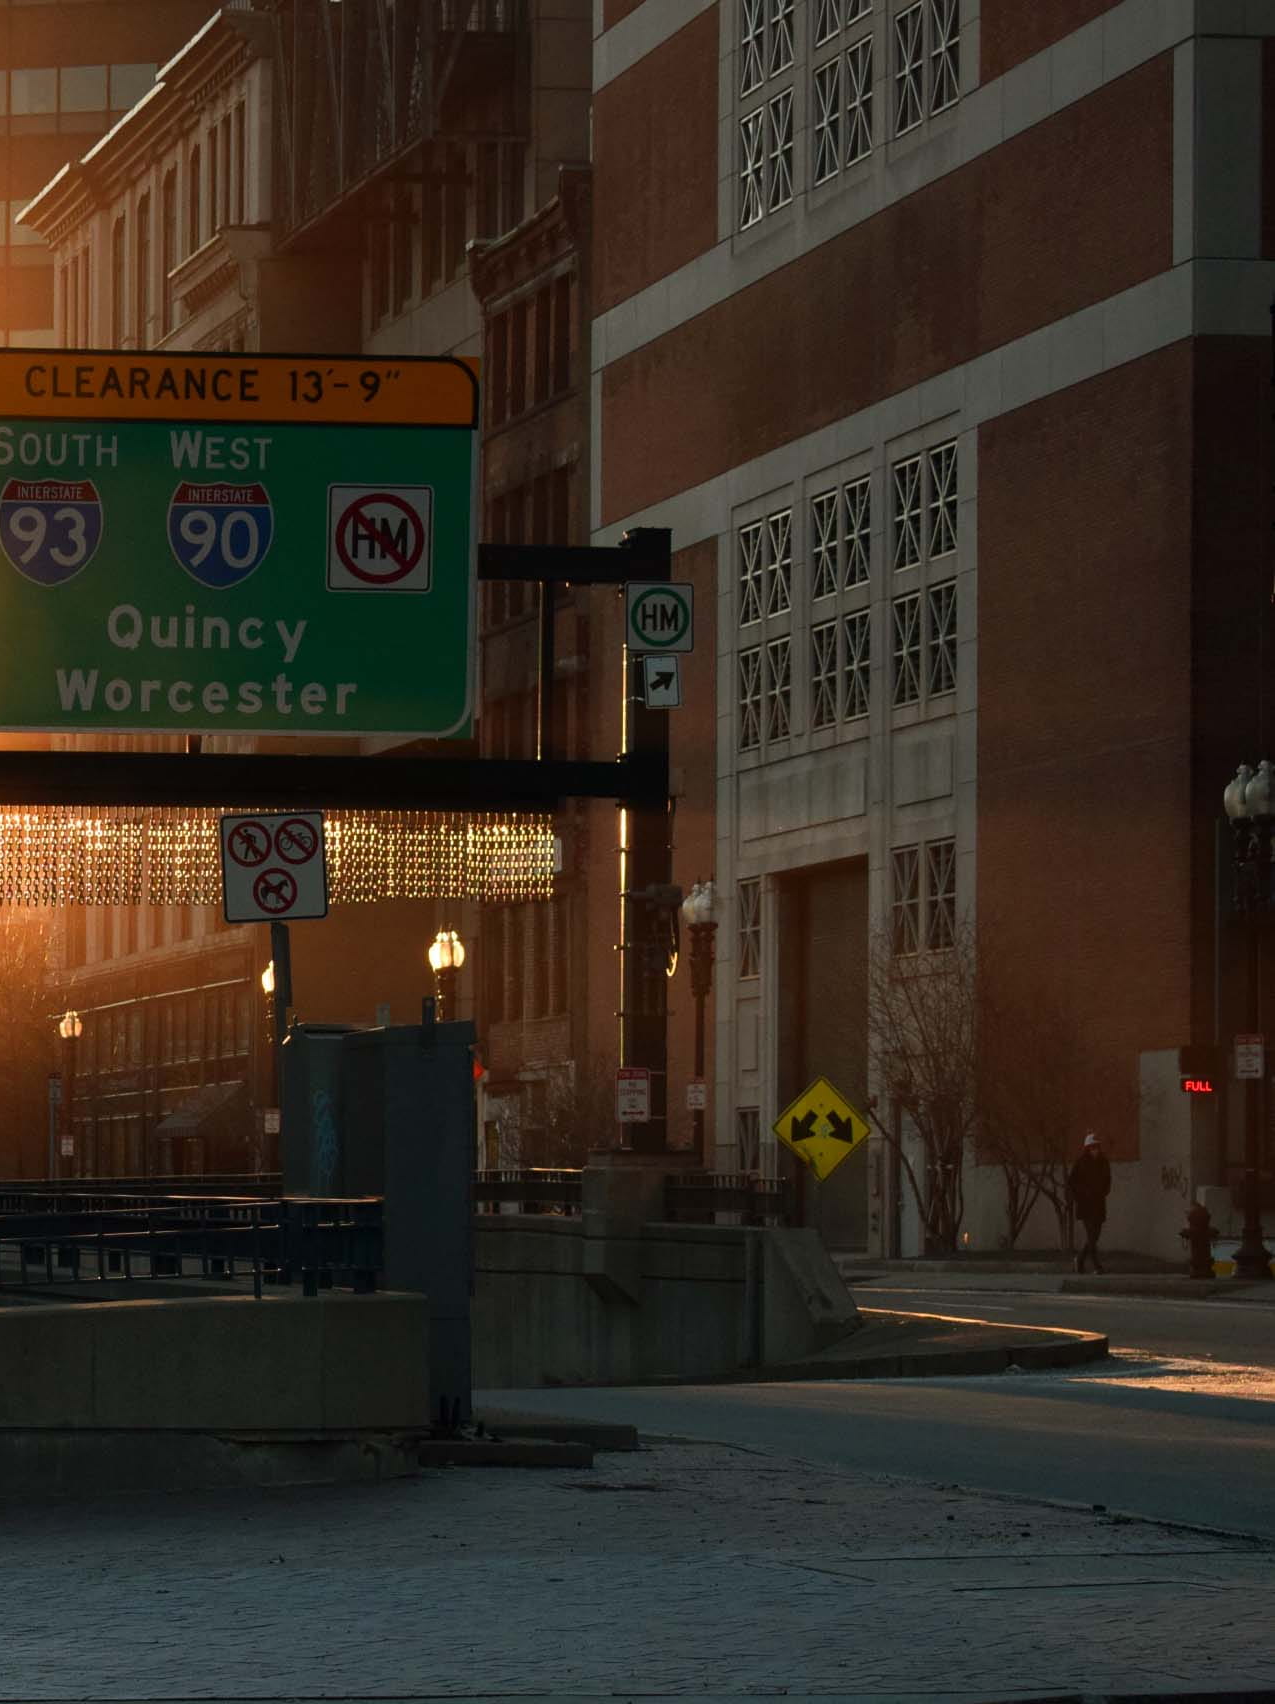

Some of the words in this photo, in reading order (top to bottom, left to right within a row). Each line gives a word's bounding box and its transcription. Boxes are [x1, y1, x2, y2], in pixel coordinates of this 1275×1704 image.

[25, 366, 260, 401] CLEARANCE
[169, 430, 273, 470] WEST
[16, 485, 84, 500] INTERSTATE
[187, 488, 254, 504] INTERSTATE
[8, 506, 88, 567] 93
[179, 510, 259, 570] 90
[351, 517, 409, 560] HM
[107, 605, 308, 663] Quincy
[641, 604, 679, 631] HM
[55, 669, 359, 716] Worcester
[1184, 1080, 1214, 1093] FULL
